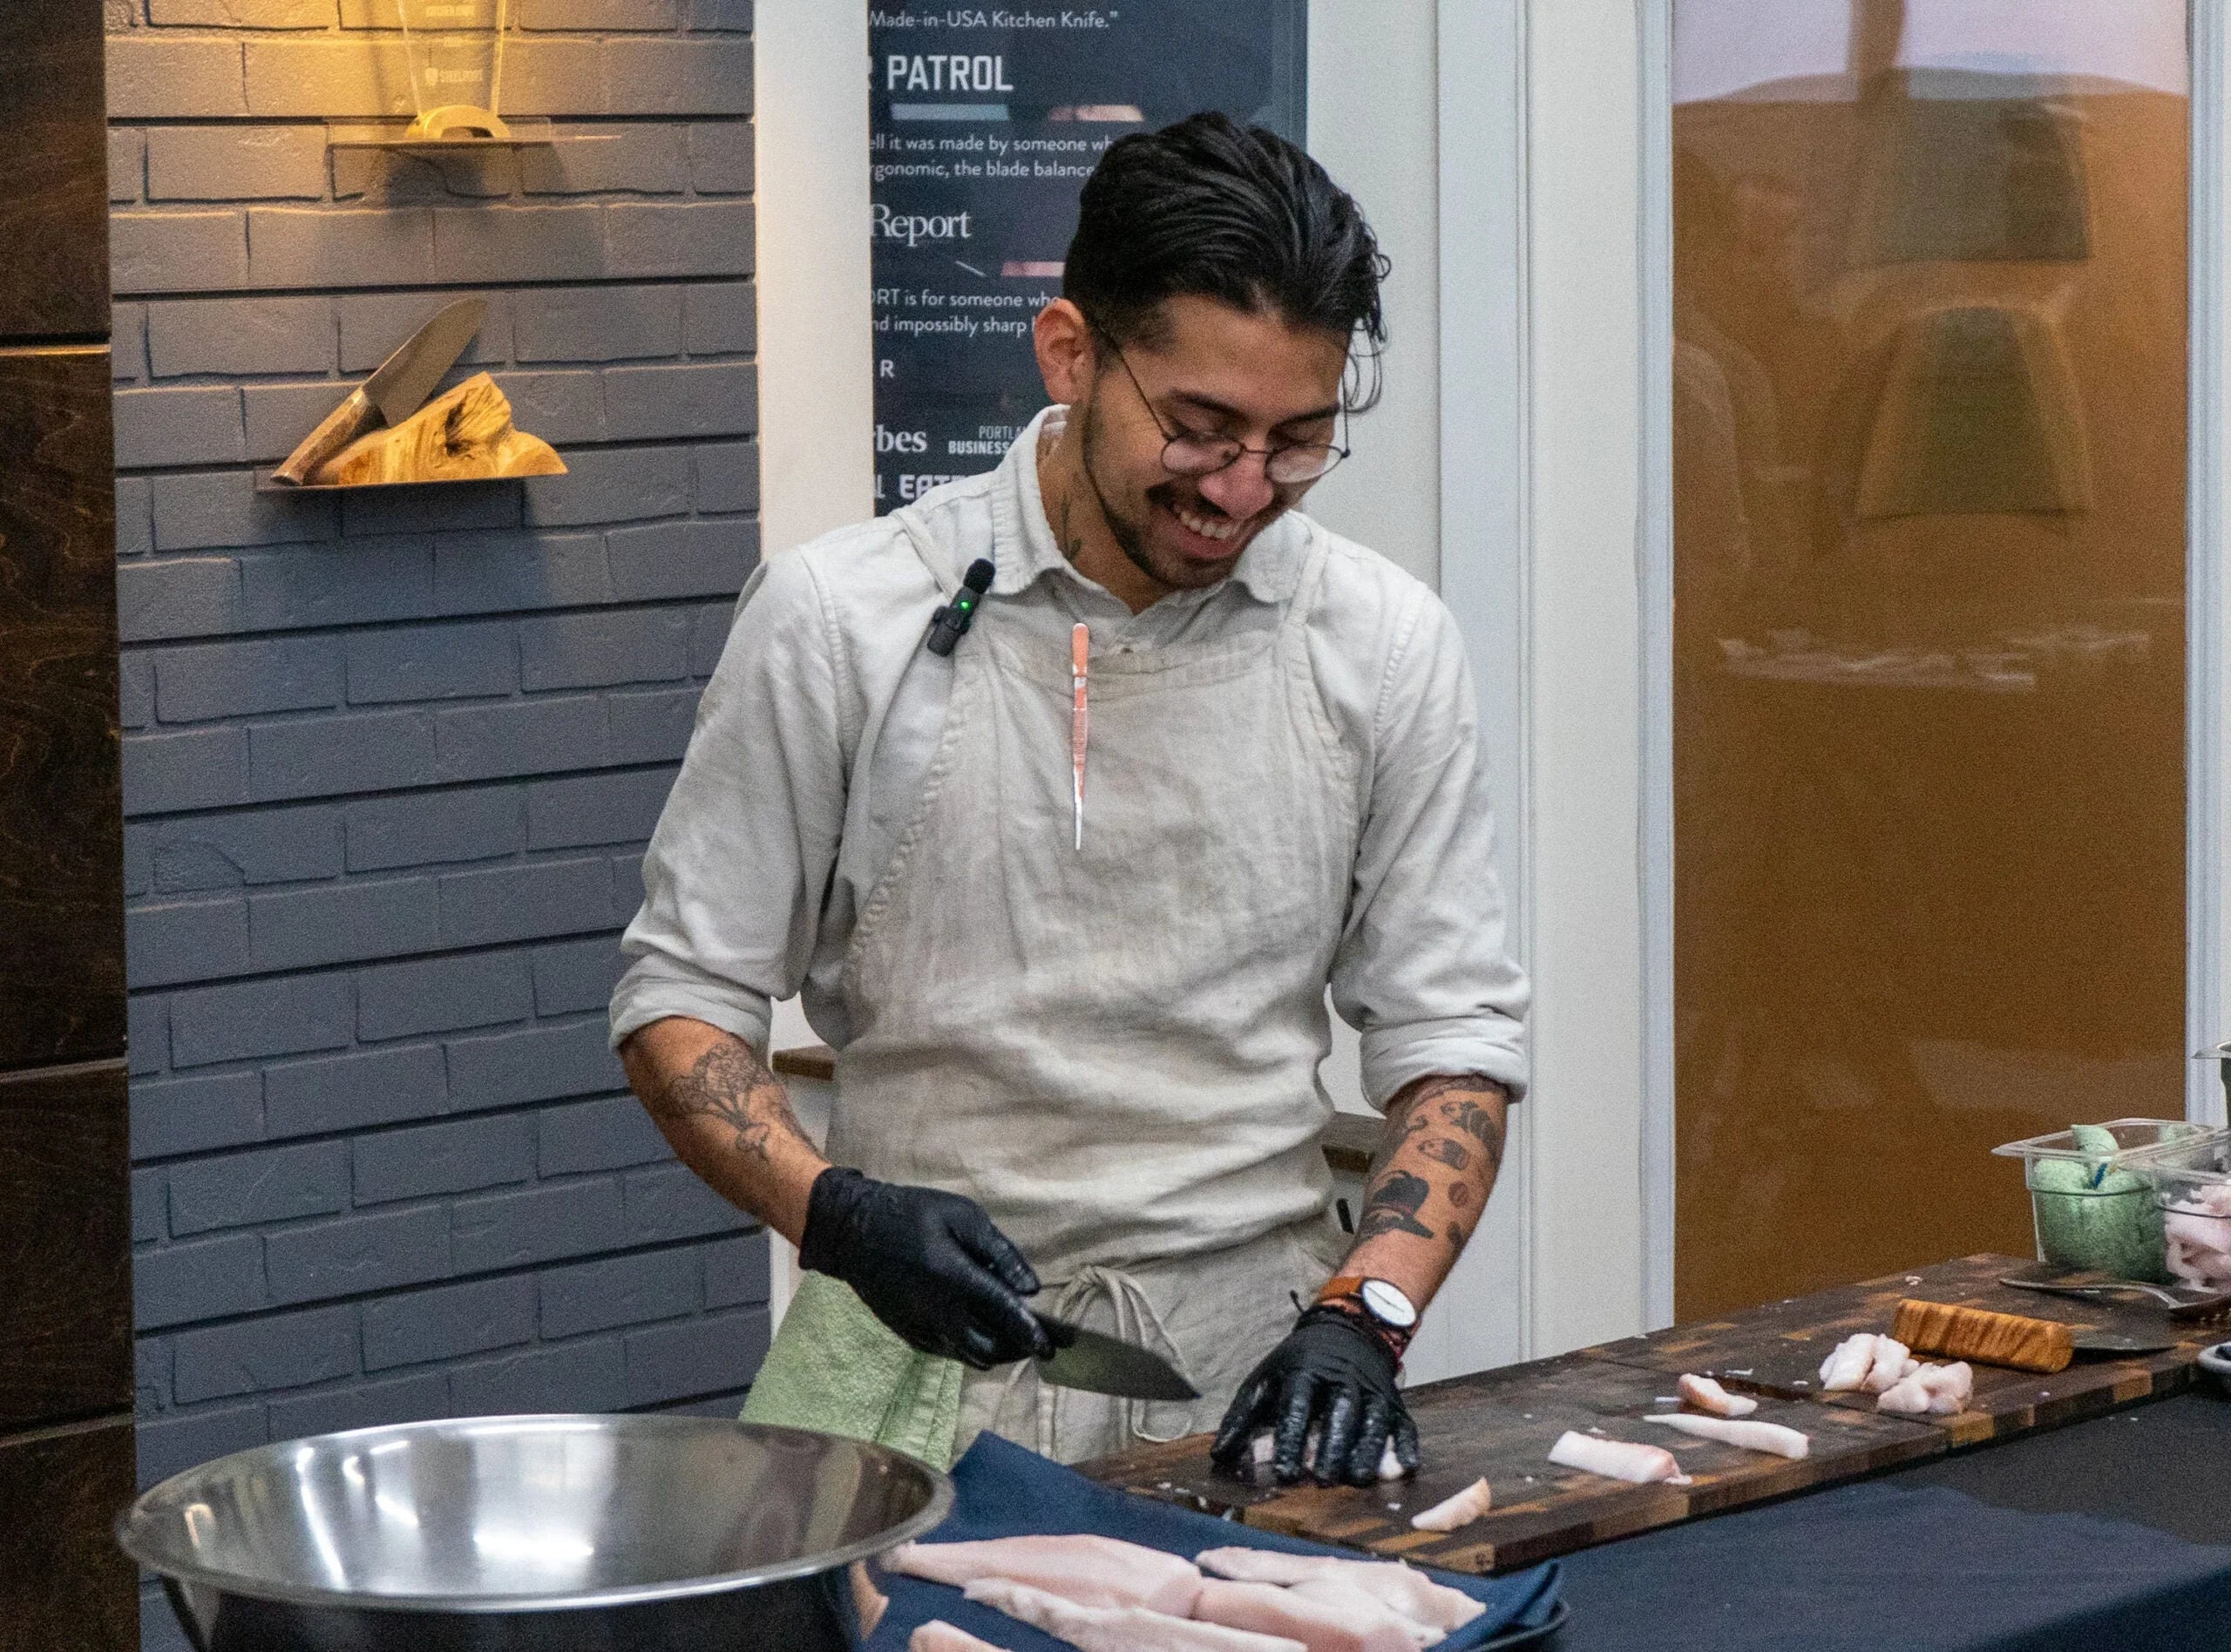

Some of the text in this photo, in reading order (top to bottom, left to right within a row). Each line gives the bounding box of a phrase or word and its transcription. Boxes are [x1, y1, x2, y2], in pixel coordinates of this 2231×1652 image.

[870, 10, 1119, 29] Made-in-USA Kitchen Knife."
[887, 55, 1014, 91] PATROL
[889, 133, 902, 150] it
[905, 139, 935, 150] was
[939, 133, 982, 151] made
[989, 133, 1009, 156] by
[1014, 139, 1087, 152] someone
[954, 159, 981, 176] the
[987, 159, 1029, 176] blade
[871, 203, 972, 247] Report
[905, 289, 917, 306] is
[921, 288, 945, 306] for
[950, 294, 1022, 307] someone
[894, 315, 978, 338] impossibly
[983, 315, 1027, 338] sharp
[880, 359, 895, 378] R
[874, 423, 927, 452] bes
[948, 440, 1011, 455] BUSINESS
